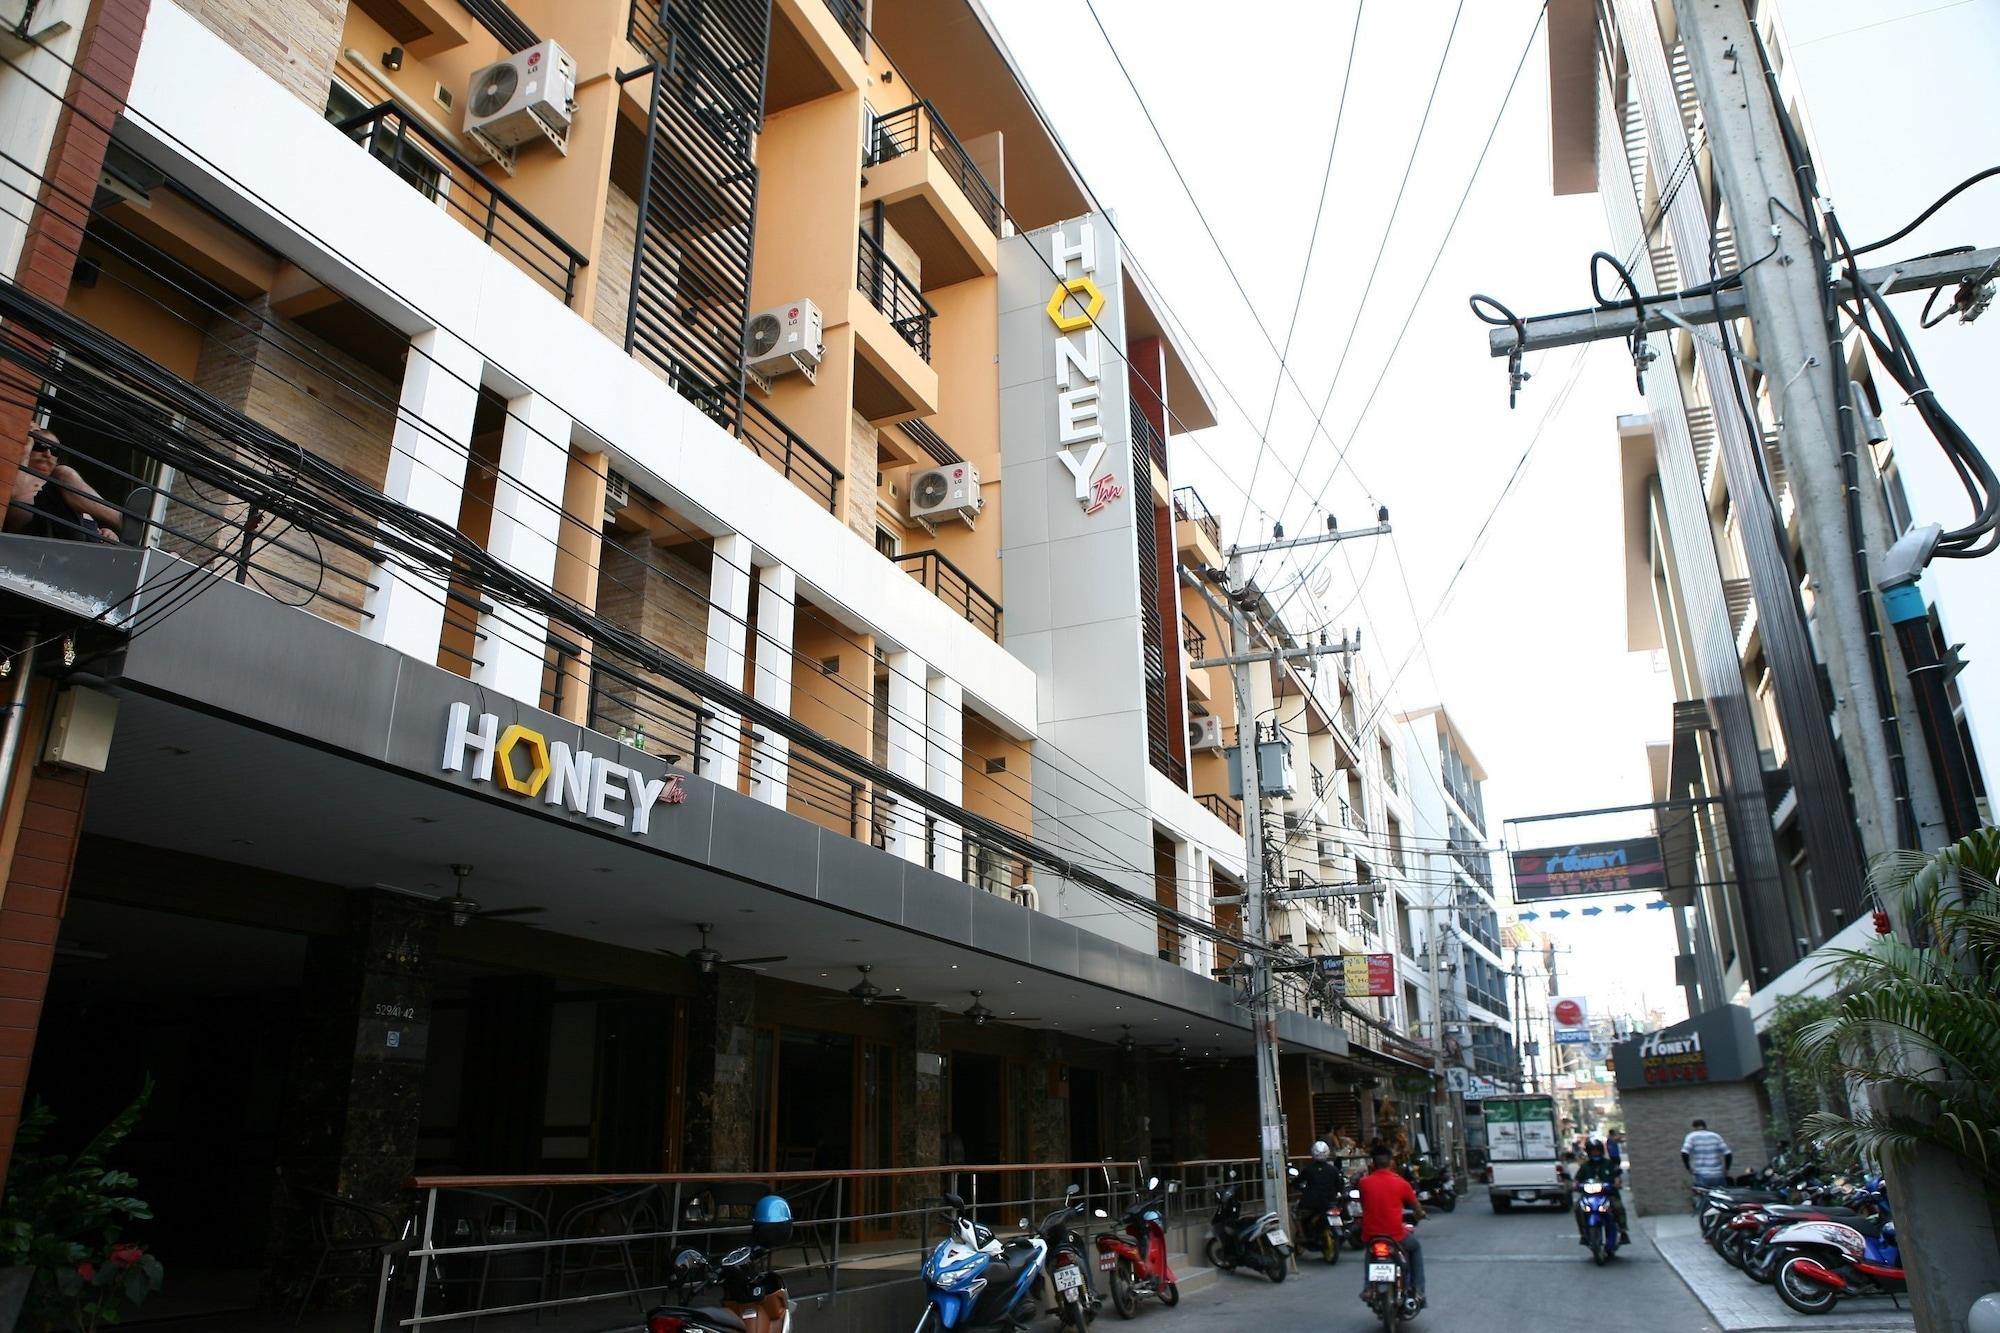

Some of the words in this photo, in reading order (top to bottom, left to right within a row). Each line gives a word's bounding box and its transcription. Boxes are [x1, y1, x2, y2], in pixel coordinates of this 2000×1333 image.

[527, 65, 538, 75] LG
[788, 318, 798, 327] LG
[1046, 222, 1107, 501] HONEY
[1087, 473, 1123, 514] Inn
[441, 702, 666, 835] HONEY
